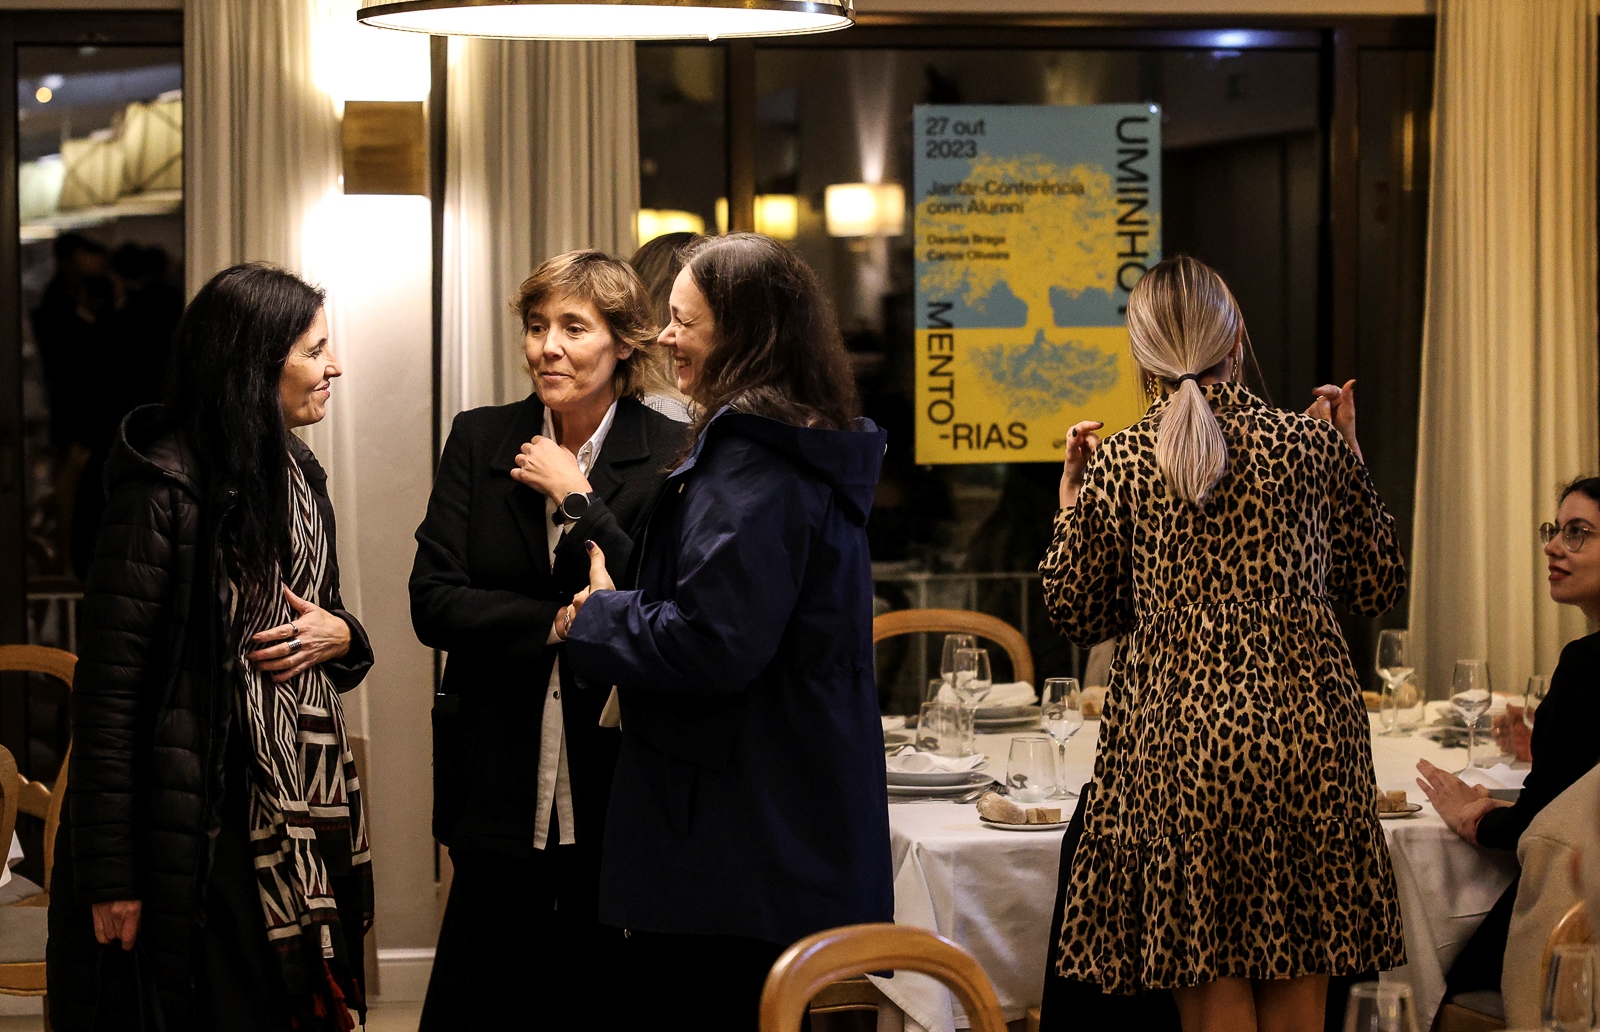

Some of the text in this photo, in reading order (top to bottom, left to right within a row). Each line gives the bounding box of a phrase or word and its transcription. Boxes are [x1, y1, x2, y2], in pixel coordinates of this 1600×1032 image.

[926, 117, 985, 136] 27 out
[926, 140, 977, 158] 2023
[927, 199, 1024, 215] com Alumni
[927, 301, 956, 425] MENTO
[939, 422, 1029, 451] -RIAS
